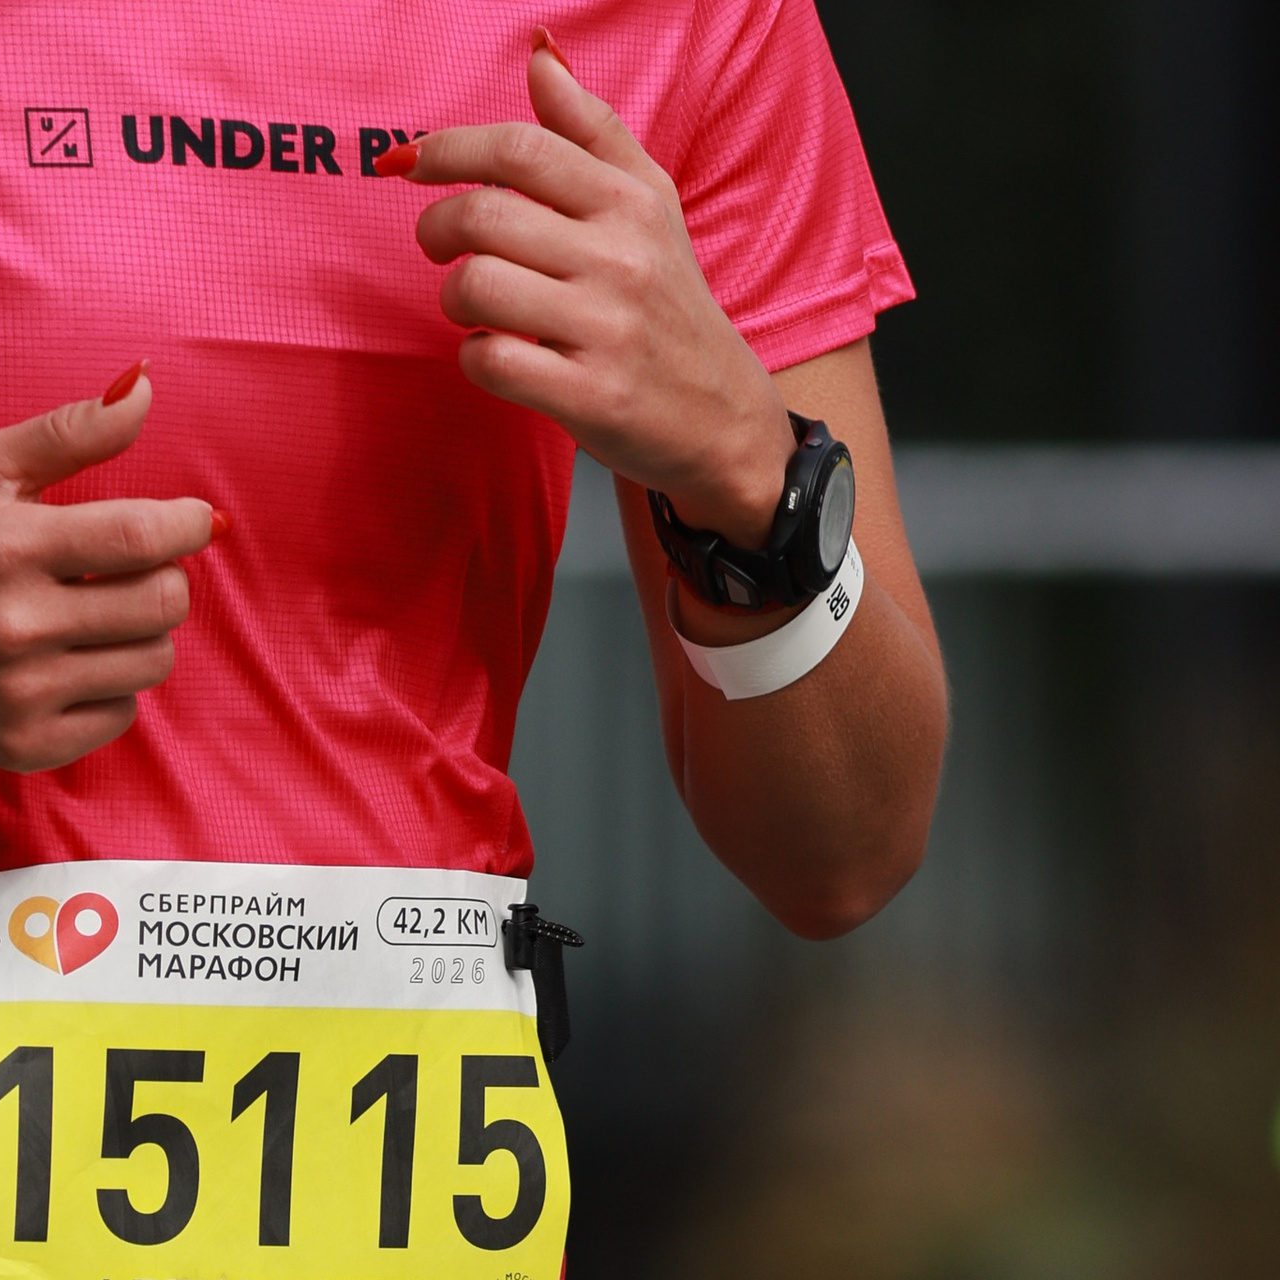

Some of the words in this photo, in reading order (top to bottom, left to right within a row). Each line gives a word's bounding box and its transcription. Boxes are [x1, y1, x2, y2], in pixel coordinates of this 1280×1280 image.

[121, 115, 343, 176] UNDER
[826, 582, 850, 622] GRi
[139, 892, 306, 918] СБЕРПРАЙМ
[138, 920, 359, 952] МОСКОВСКИЙ
[393, 907, 446, 939] 42,2
[457, 908, 488, 936] КМ
[137, 955, 301, 983] МАРАФОН
[409, 957, 485, 985] 2026
